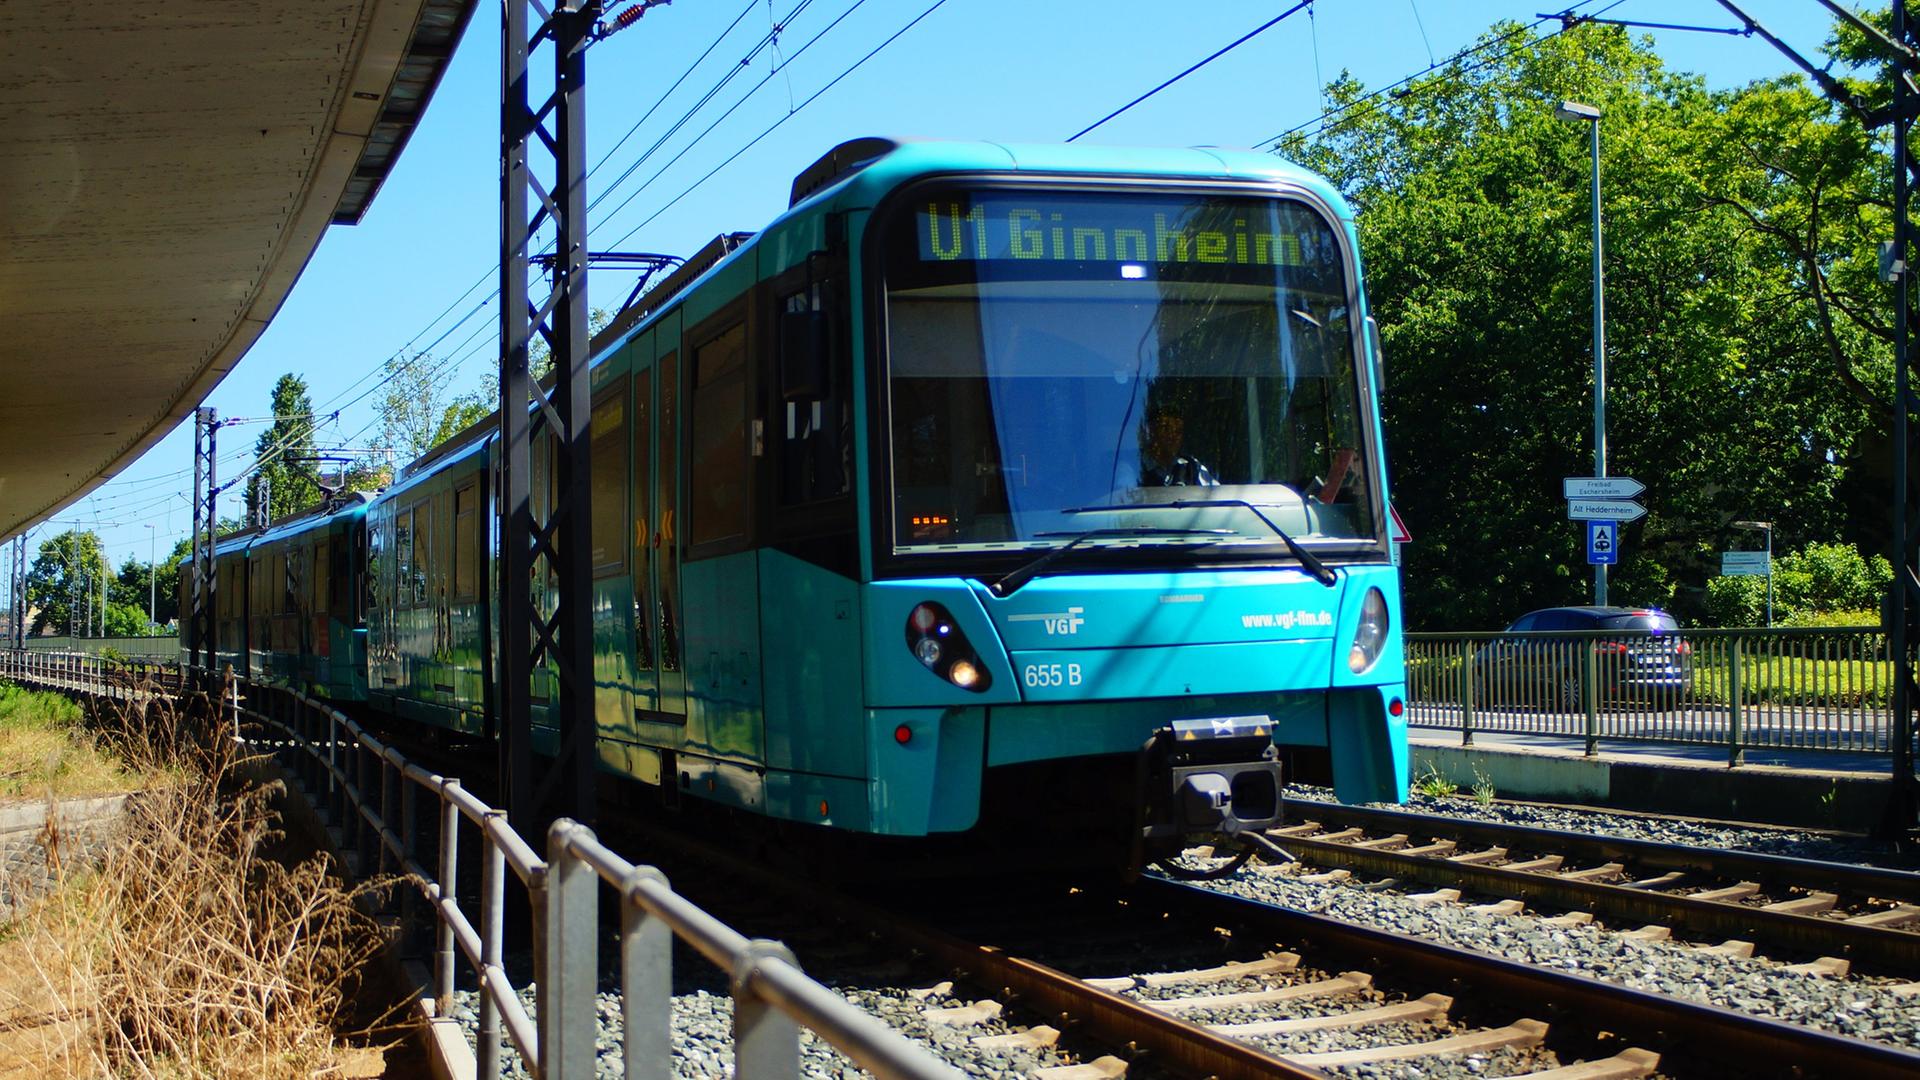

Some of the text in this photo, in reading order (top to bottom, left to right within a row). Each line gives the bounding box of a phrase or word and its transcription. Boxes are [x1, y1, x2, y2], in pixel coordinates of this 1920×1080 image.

[929, 203, 1300, 266] U1 Ginnheim
[1573, 505, 1633, 514] Alt Heddernheim
[1044, 607, 1084, 635] VGF
[1025, 663, 1082, 687] 655 B
